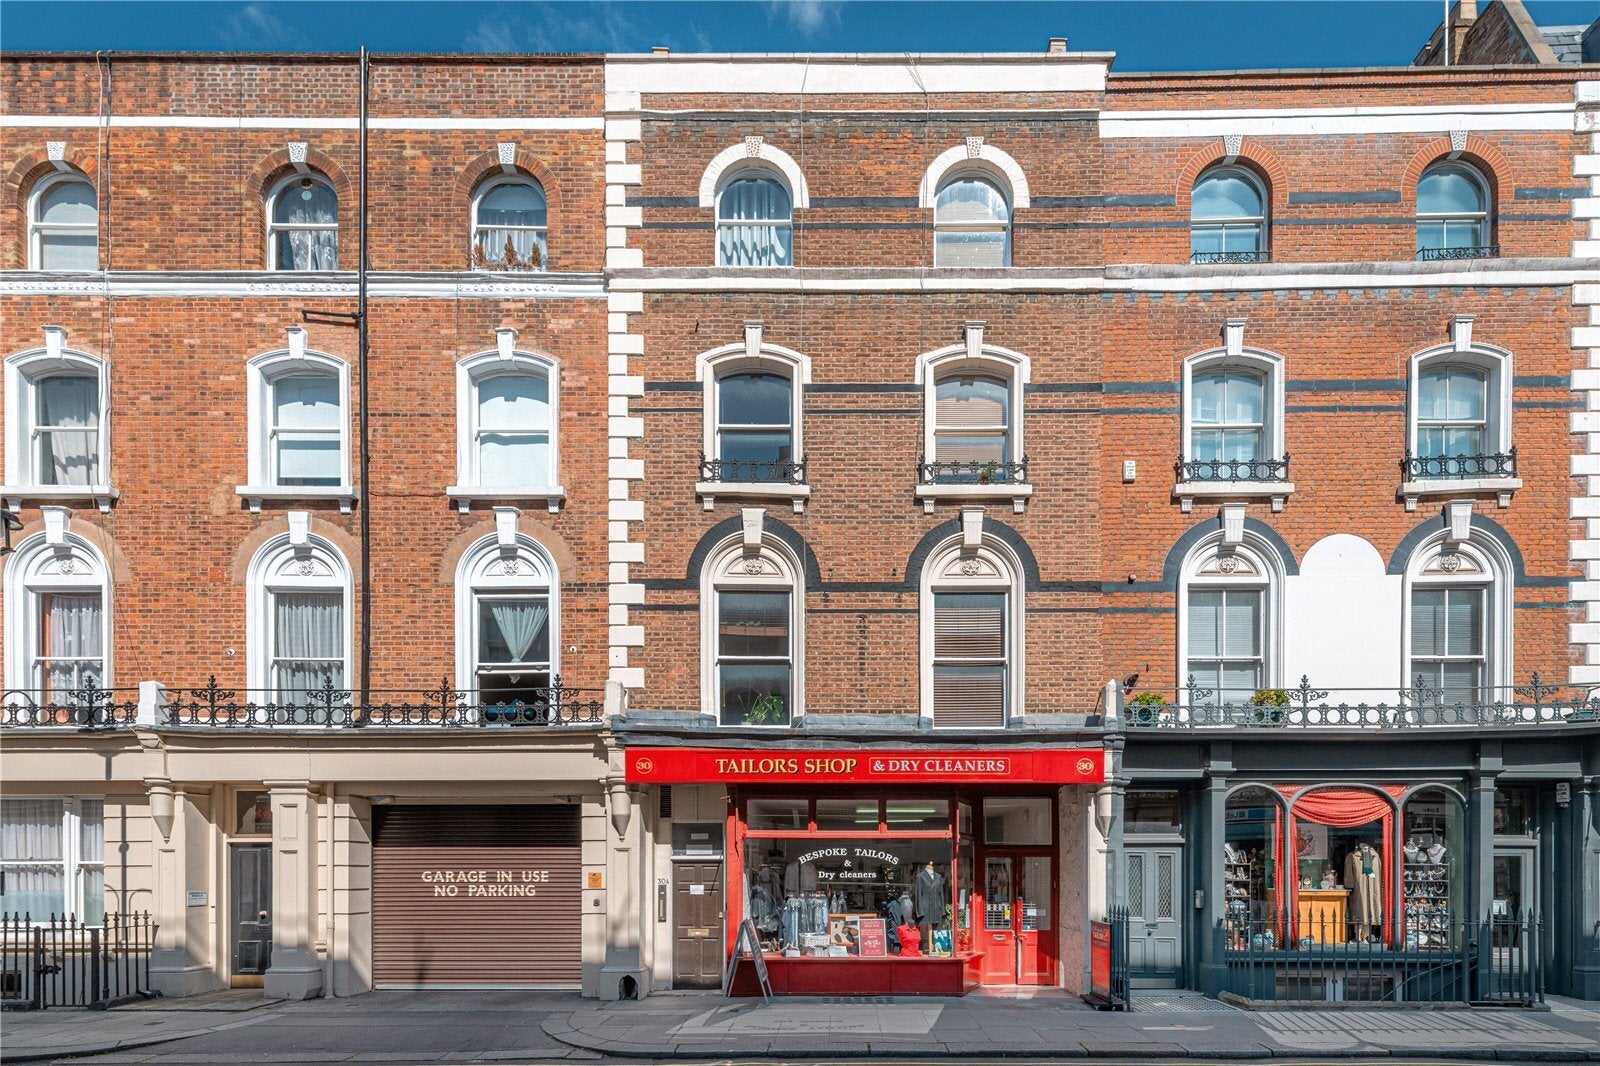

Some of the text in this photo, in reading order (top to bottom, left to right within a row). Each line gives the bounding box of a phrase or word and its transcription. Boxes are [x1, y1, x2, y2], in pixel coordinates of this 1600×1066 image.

[716, 758, 857, 774] TAILORS SHOP
[873, 760, 1005, 772] & DRY CLEANERS
[798, 848, 899, 865] BESPOKE TAILORS
[421, 871, 549, 882] GARAGE IN USE
[818, 871, 835, 880] Dry
[434, 885, 536, 896] NO PARKING
